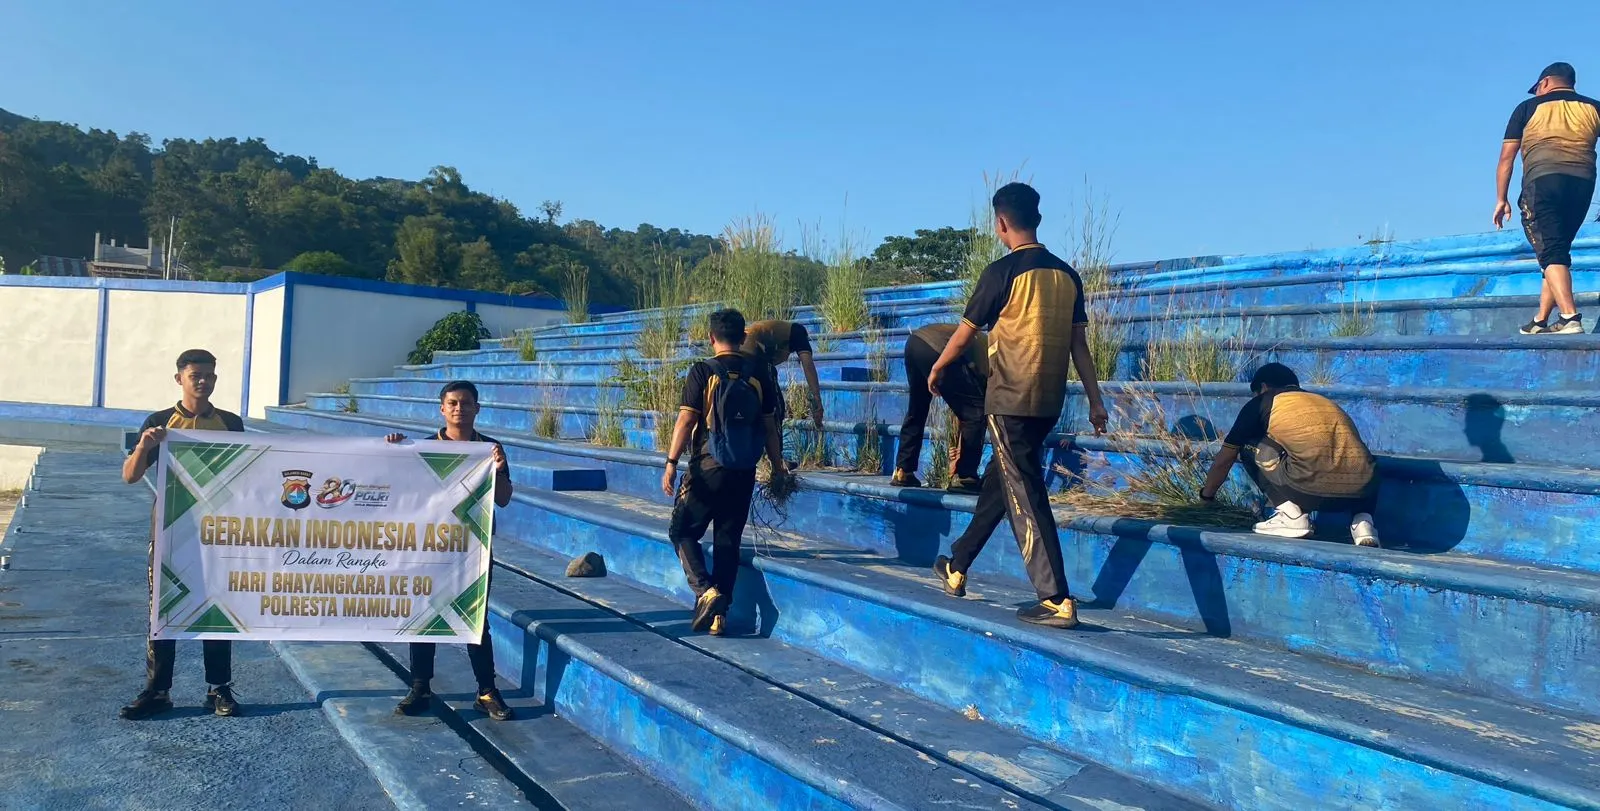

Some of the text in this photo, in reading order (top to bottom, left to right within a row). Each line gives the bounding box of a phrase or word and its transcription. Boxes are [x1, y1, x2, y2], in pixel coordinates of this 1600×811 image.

[321, 476, 356, 502] 80
[354, 491, 390, 502] POLRI
[200, 516, 469, 552] GERAKAN INDONESIA ASRI
[282, 549, 389, 573] Dalam Rangka
[228, 571, 432, 595] HARI BHAYANGKARA KE 80
[260, 595, 411, 618] POLRESTA MAMUJU
